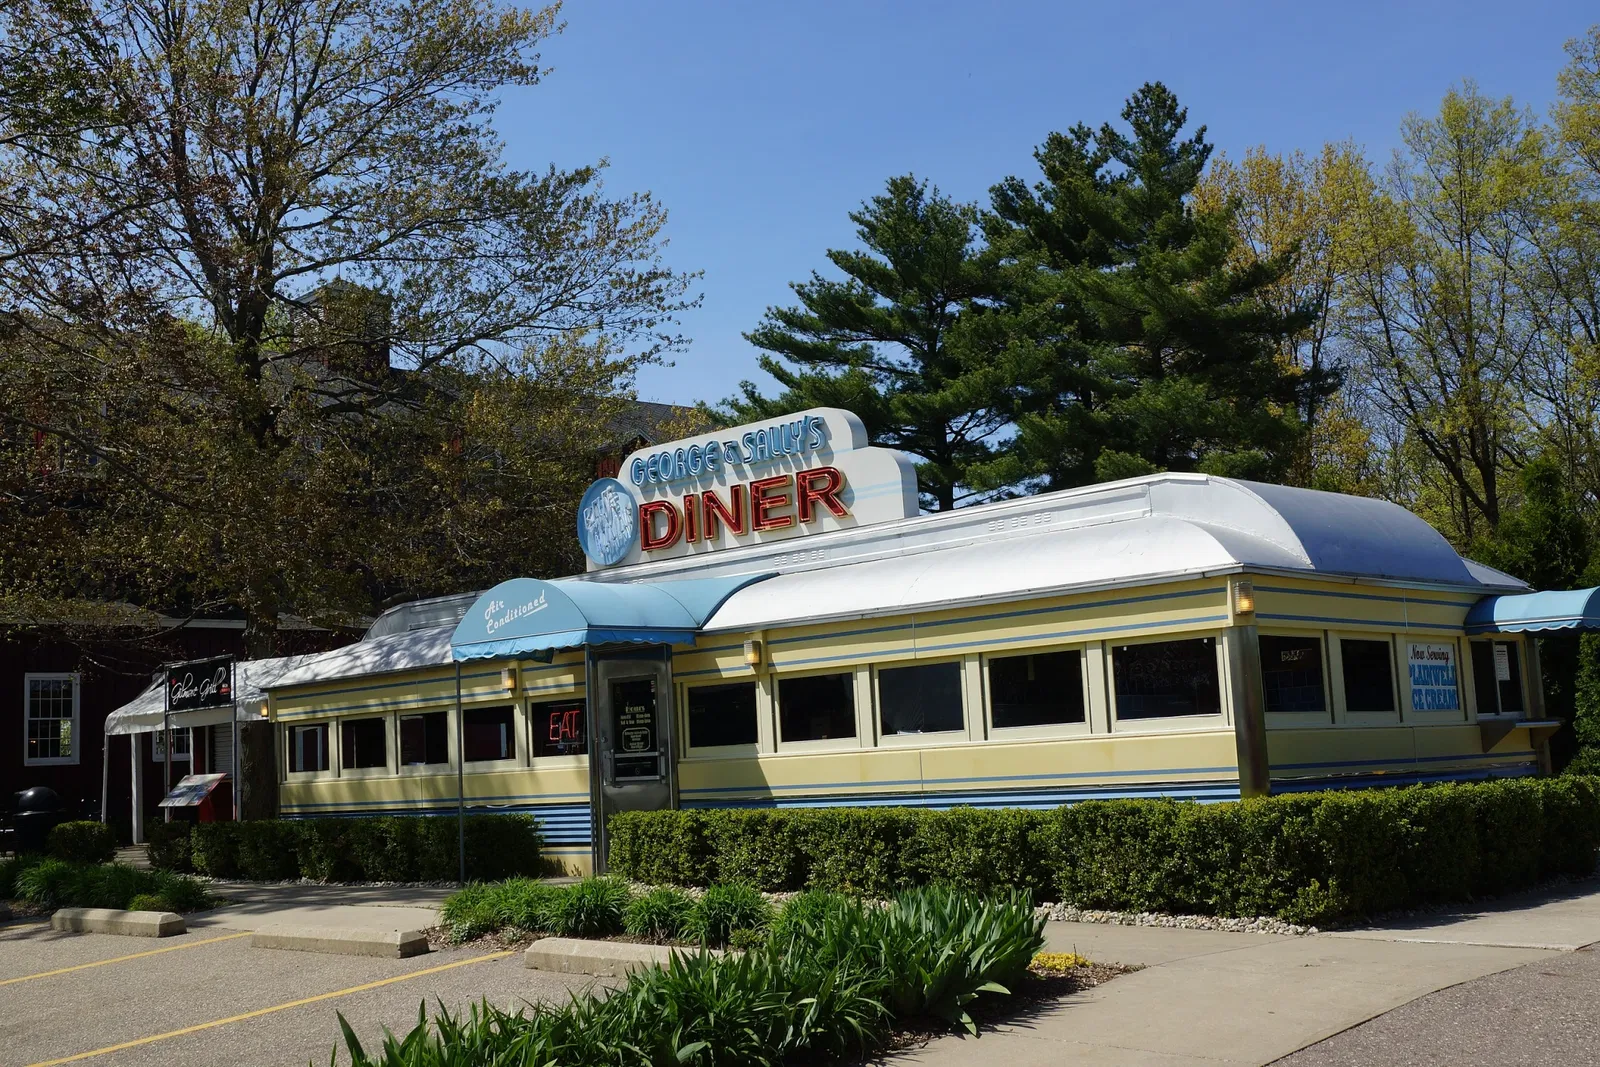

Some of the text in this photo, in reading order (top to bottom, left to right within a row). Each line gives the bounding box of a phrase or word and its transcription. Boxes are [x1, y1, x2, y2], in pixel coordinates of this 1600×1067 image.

[631, 415, 827, 487] GEORGE & SALLY'S
[640, 467, 852, 552] DINER
[485, 599, 504, 619] Air
[486, 589, 546, 634] Conditioned
[1411, 644, 1449, 664] Now Serving
[199, 667, 227, 701] Grill
[1425, 689, 1457, 709] CREAM
[550, 710, 580, 740] EAT
